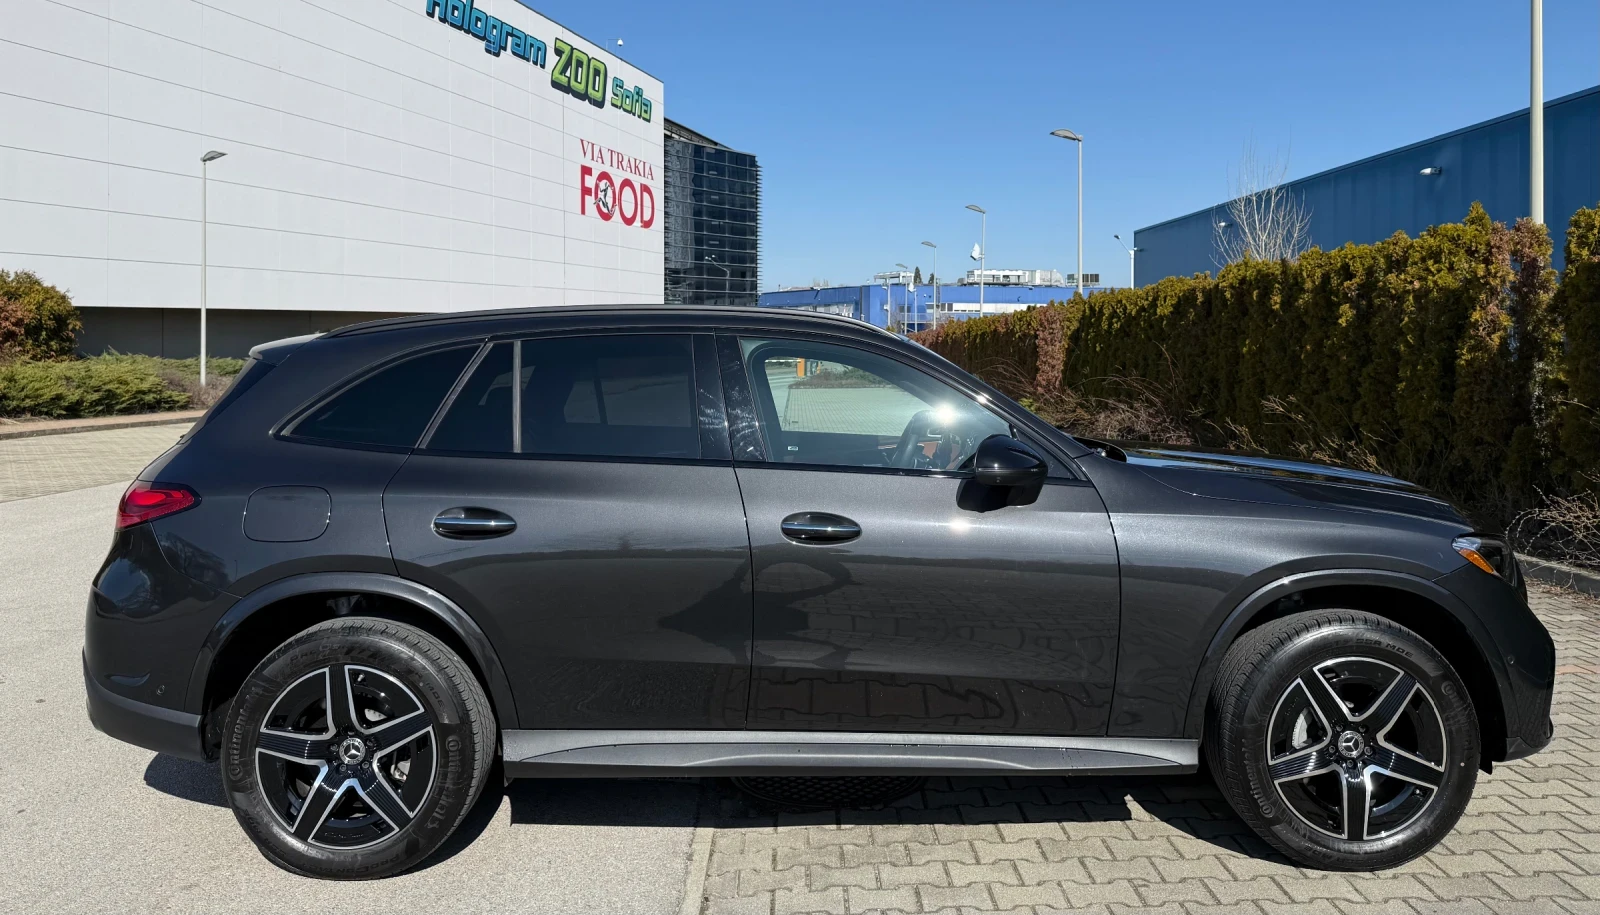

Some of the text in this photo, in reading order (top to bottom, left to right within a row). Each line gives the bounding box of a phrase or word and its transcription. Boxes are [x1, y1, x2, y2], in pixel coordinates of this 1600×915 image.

[551, 38, 608, 109] ZOO
[611, 77, 652, 123] Sofia
[580, 139, 655, 181] VIA TRAKIA
[580, 165, 655, 229] FOOD
